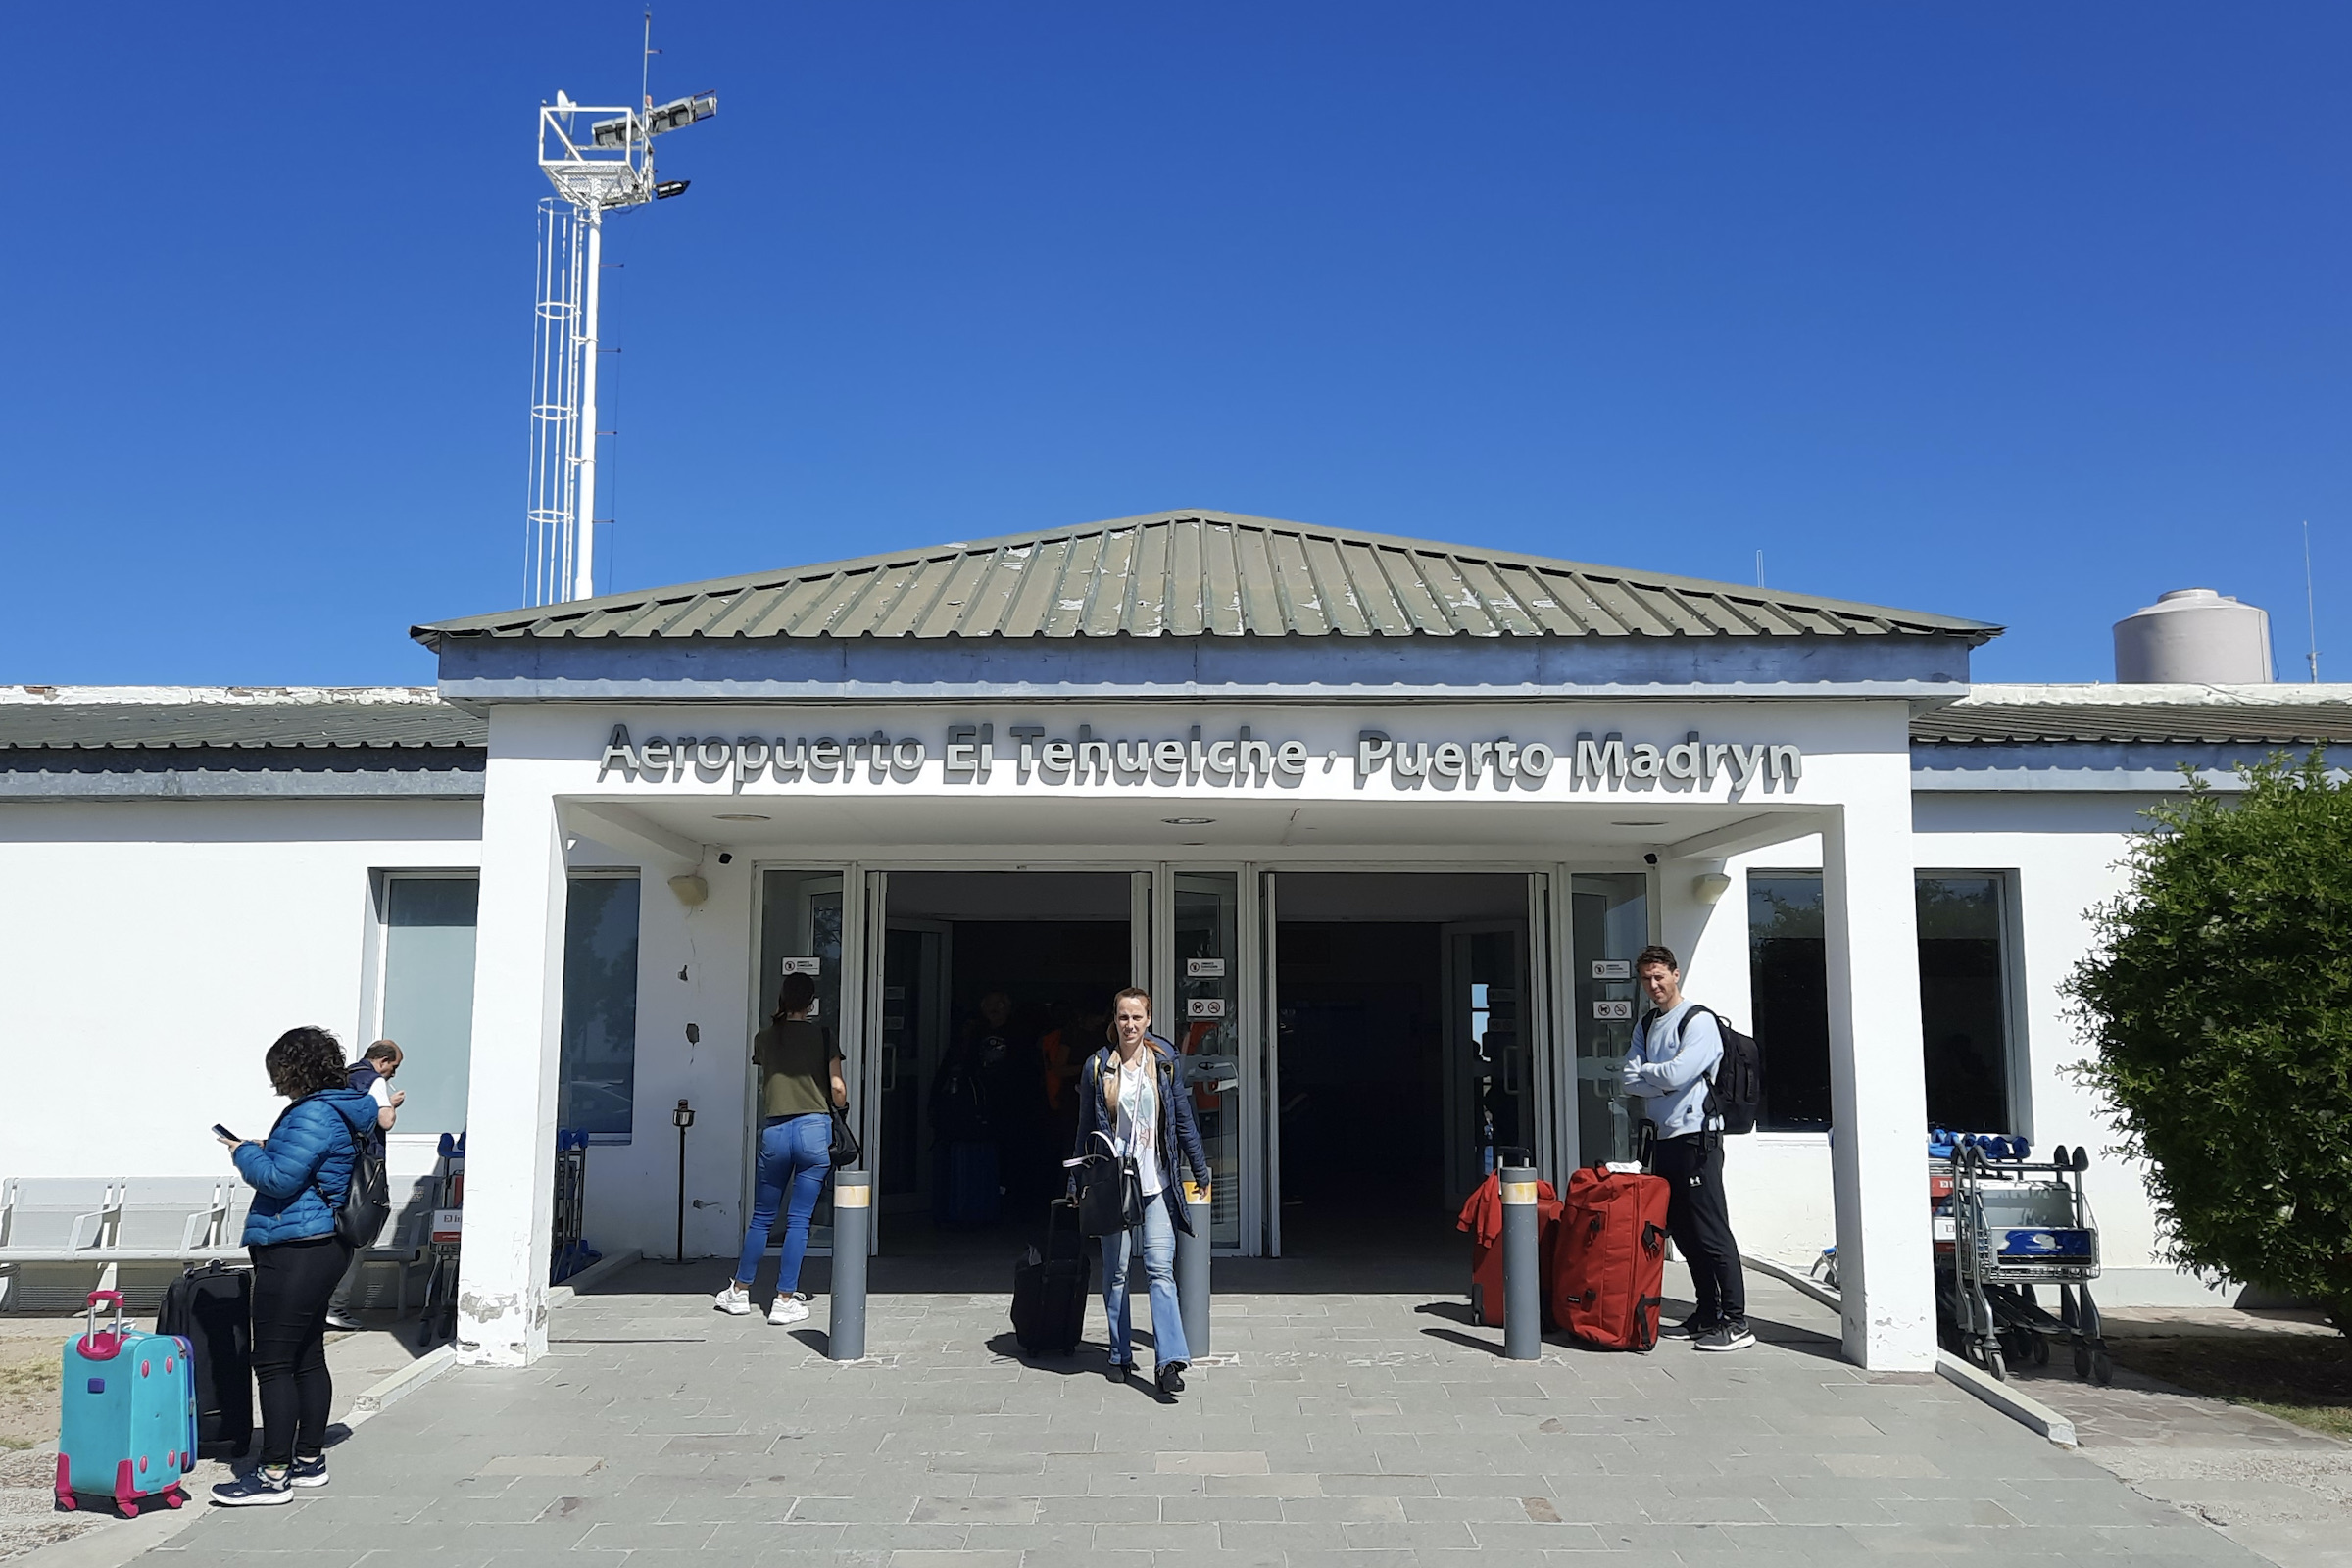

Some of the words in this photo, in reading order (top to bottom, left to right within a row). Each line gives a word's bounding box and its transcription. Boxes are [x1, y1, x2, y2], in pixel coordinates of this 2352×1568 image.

[599, 723, 927, 781] Aeropuerto
[946, 723, 993, 772] El
[1009, 724, 1308, 776] Tehuelche
[1358, 729, 1555, 778] Puerto
[1575, 730, 1802, 790] Madryn
